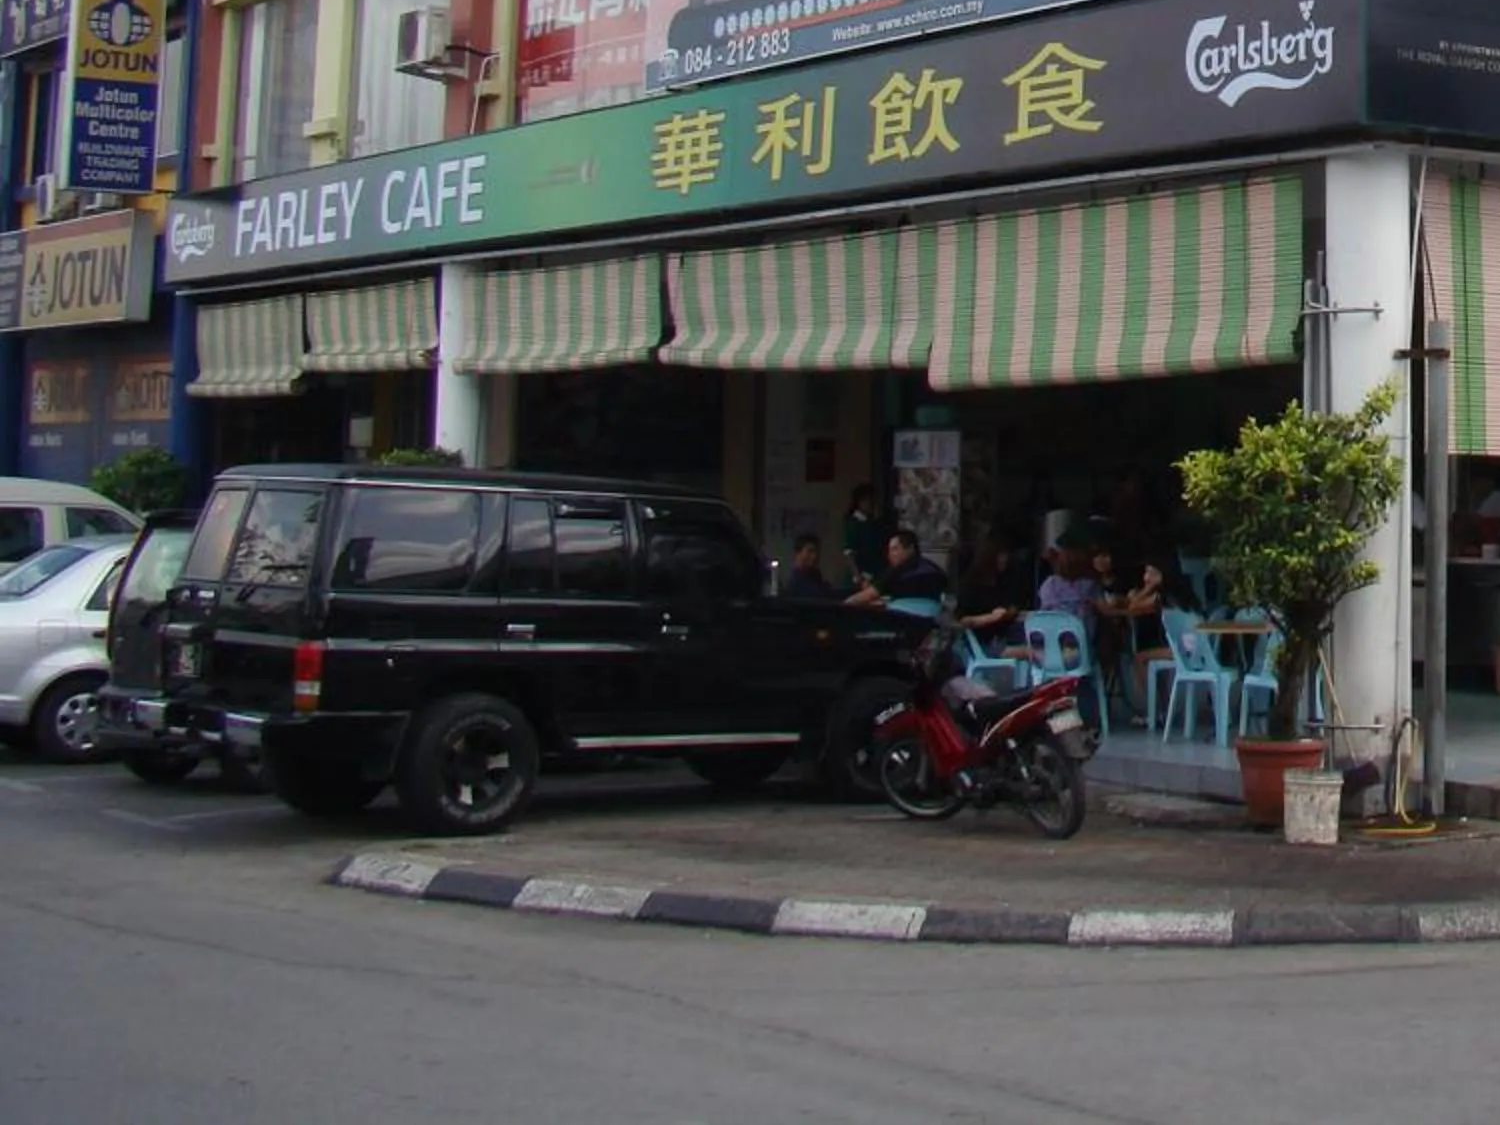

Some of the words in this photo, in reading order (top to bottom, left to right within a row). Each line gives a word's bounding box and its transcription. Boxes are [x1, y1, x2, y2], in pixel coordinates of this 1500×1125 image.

[79, 48, 159, 73] JOTUN
[684, 46, 714, 75] 084
[726, 34, 756, 67] 212
[760, 28, 791, 58] 883
[1185, 7, 1335, 97] Carlsberg
[75, 101, 155, 123] Multicolor
[94, 86, 139, 104] Jotun
[649, 41, 1108, 196] 華利飲食
[87, 120, 140, 140] Centre
[234, 177, 365, 257] FARLEY
[380, 154, 488, 235] CAFE
[171, 209, 215, 259] Carlsberg
[47, 244, 128, 314] JOTUN
